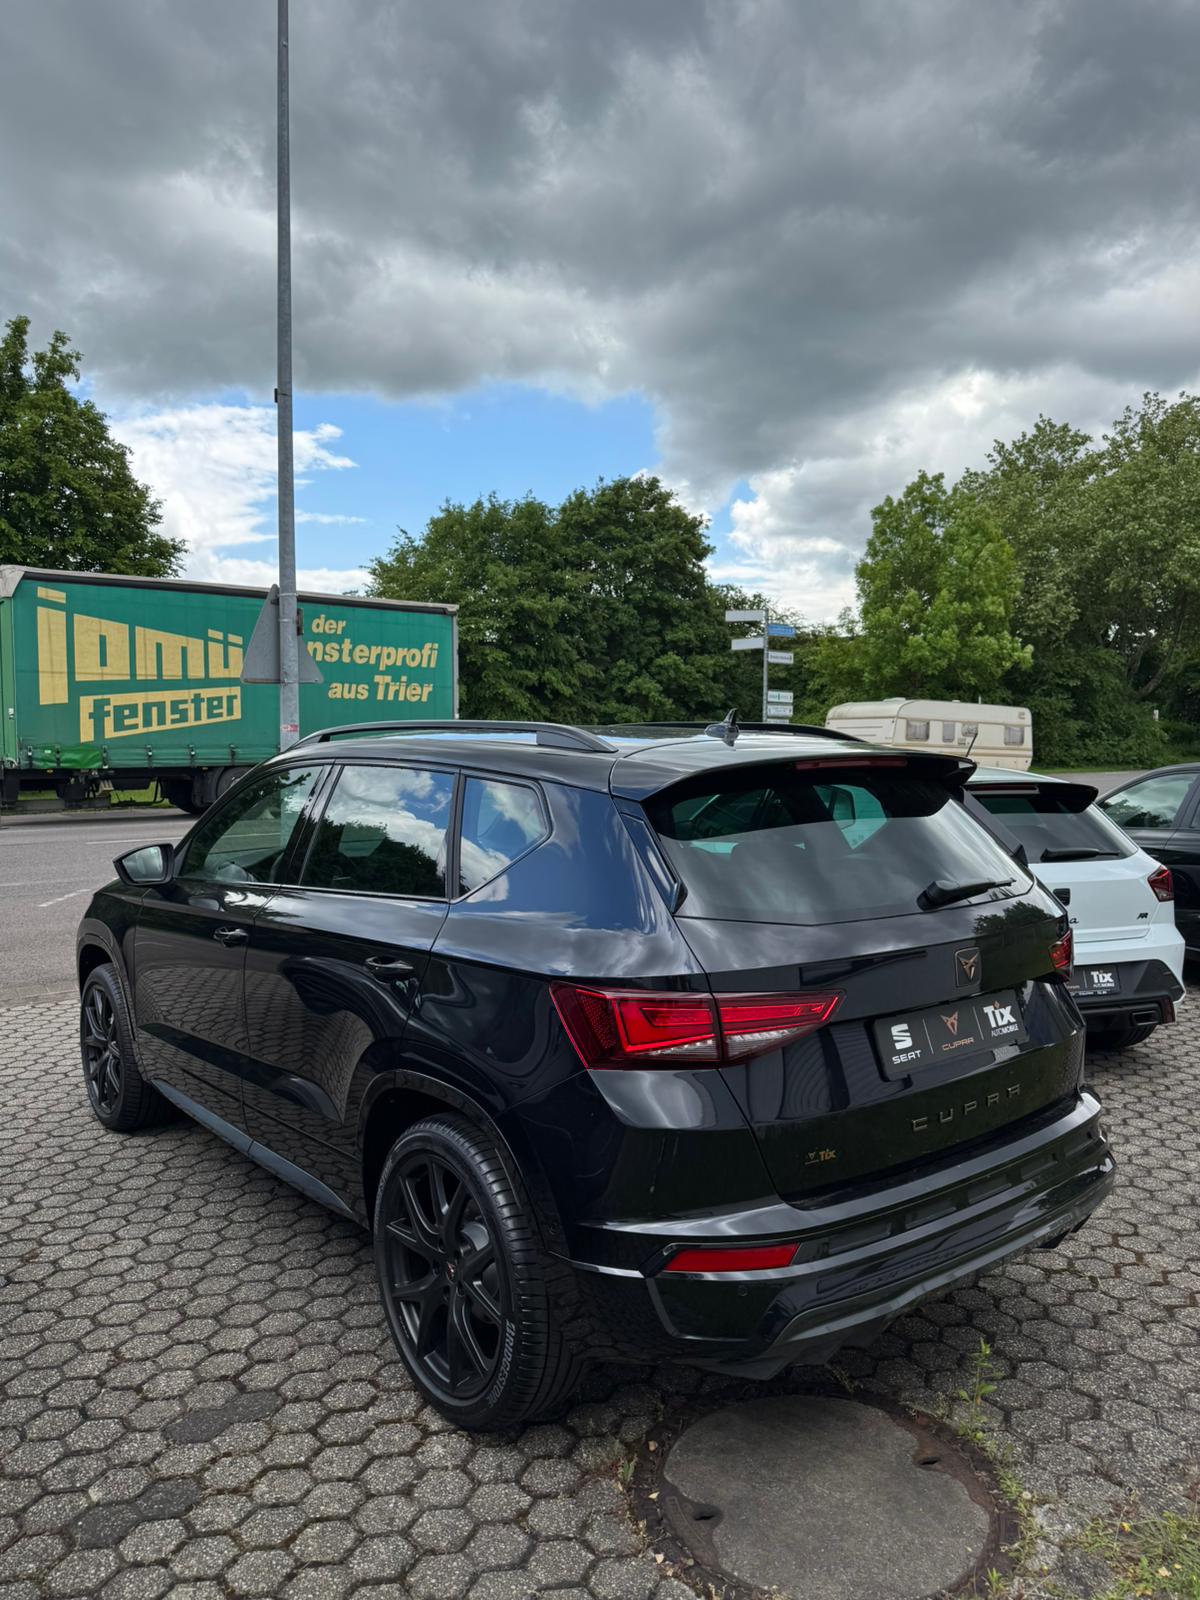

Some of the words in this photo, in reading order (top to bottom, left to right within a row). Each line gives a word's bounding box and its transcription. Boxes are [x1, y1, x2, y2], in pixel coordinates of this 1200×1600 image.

[311, 614, 346, 634] der
[307, 638, 439, 671] nsterprofi
[328, 682, 369, 700] aus
[374, 675, 433, 703] Trier
[86, 692, 239, 743] fenster
[983, 1001, 1017, 1028] Tix
[941, 1036, 975, 1051] CUPRA
[991, 1023, 1019, 1037] AUTOMOBILE
[891, 1049, 922, 1065] SEAT
[911, 1084, 1020, 1132] CUPRA
